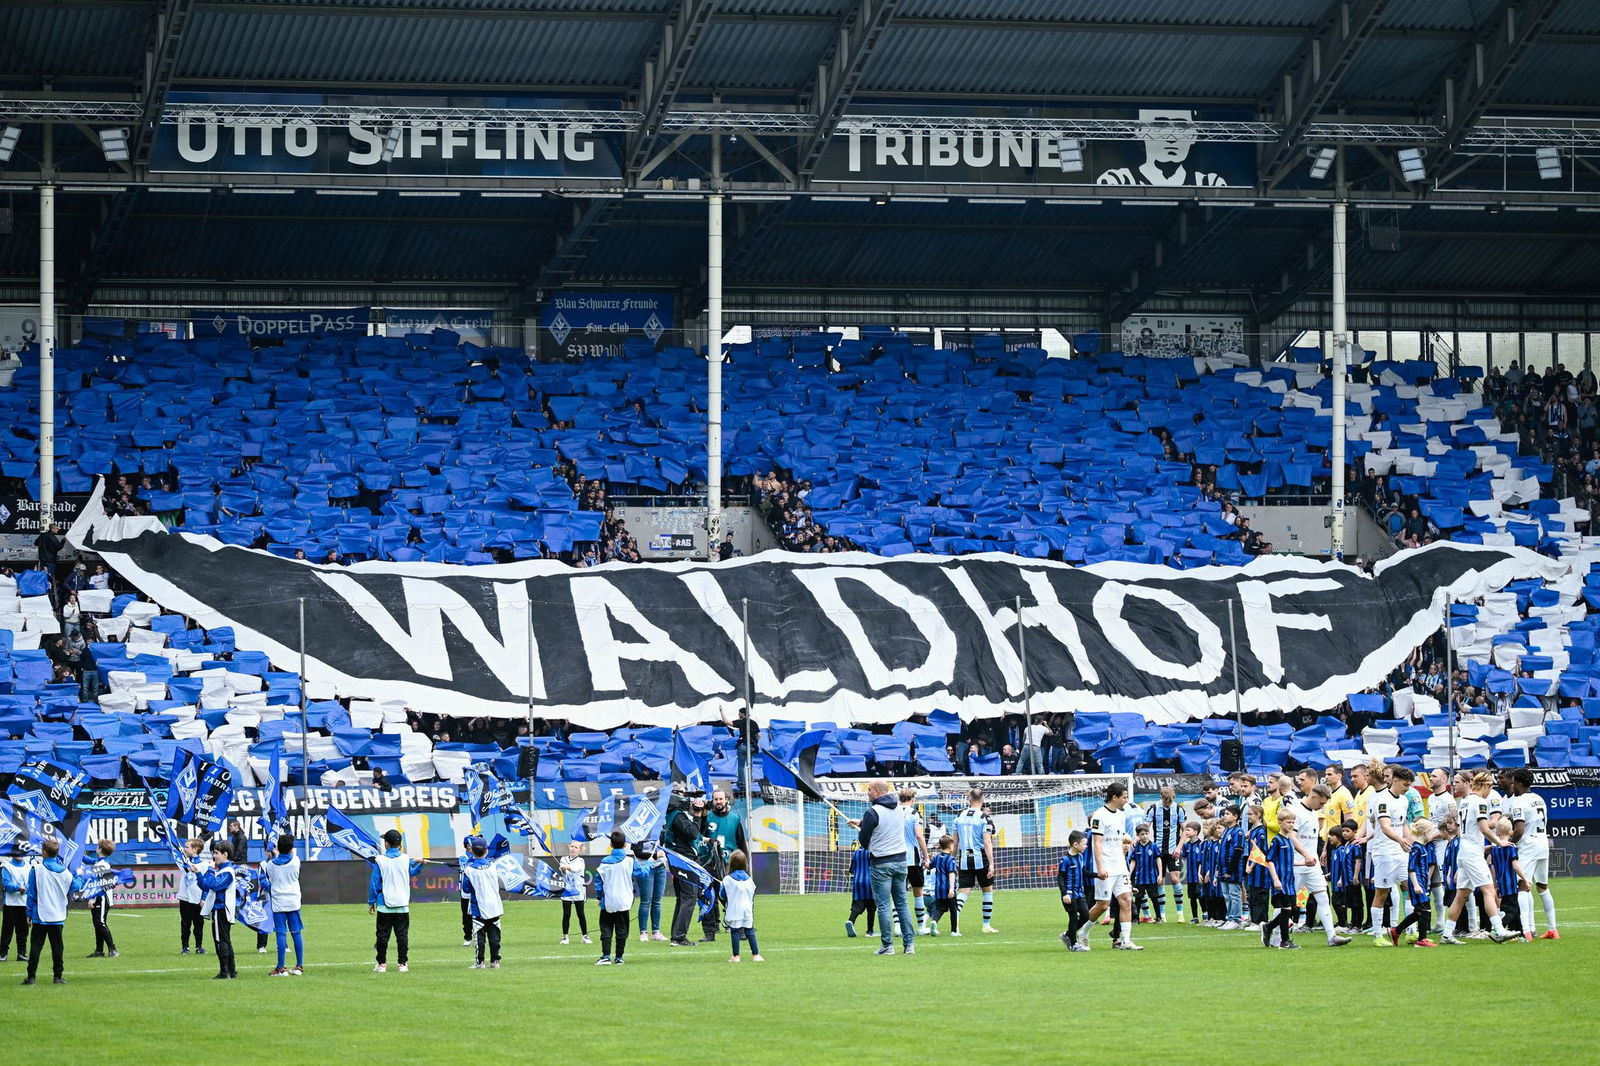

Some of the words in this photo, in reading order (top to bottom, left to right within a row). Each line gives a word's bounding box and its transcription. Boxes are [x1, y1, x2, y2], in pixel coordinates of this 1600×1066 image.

[177, 111, 318, 163] OTTO
[347, 113, 595, 166] SIFFLING
[555, 298, 577, 309] Blau
[578, 298, 620, 310] Schwarze
[621, 298, 659, 311] Freunde
[311, 566, 1344, 700] WALDHOF
[203, 775, 232, 794] JAHRE
[1133, 776, 1174, 791] OWER
[1545, 772, 1571, 784] ACHT
[91, 795, 149, 807] ASOZIAL
[301, 786, 381, 810] JEDEN
[384, 785, 457, 808] PREIS
[1550, 797, 1593, 808] SUPER
[85, 816, 128, 845] NUR
[1547, 826, 1585, 838] DHOF
[122, 874, 175, 889] OHN
[113, 892, 178, 900] RANDSCHUT
